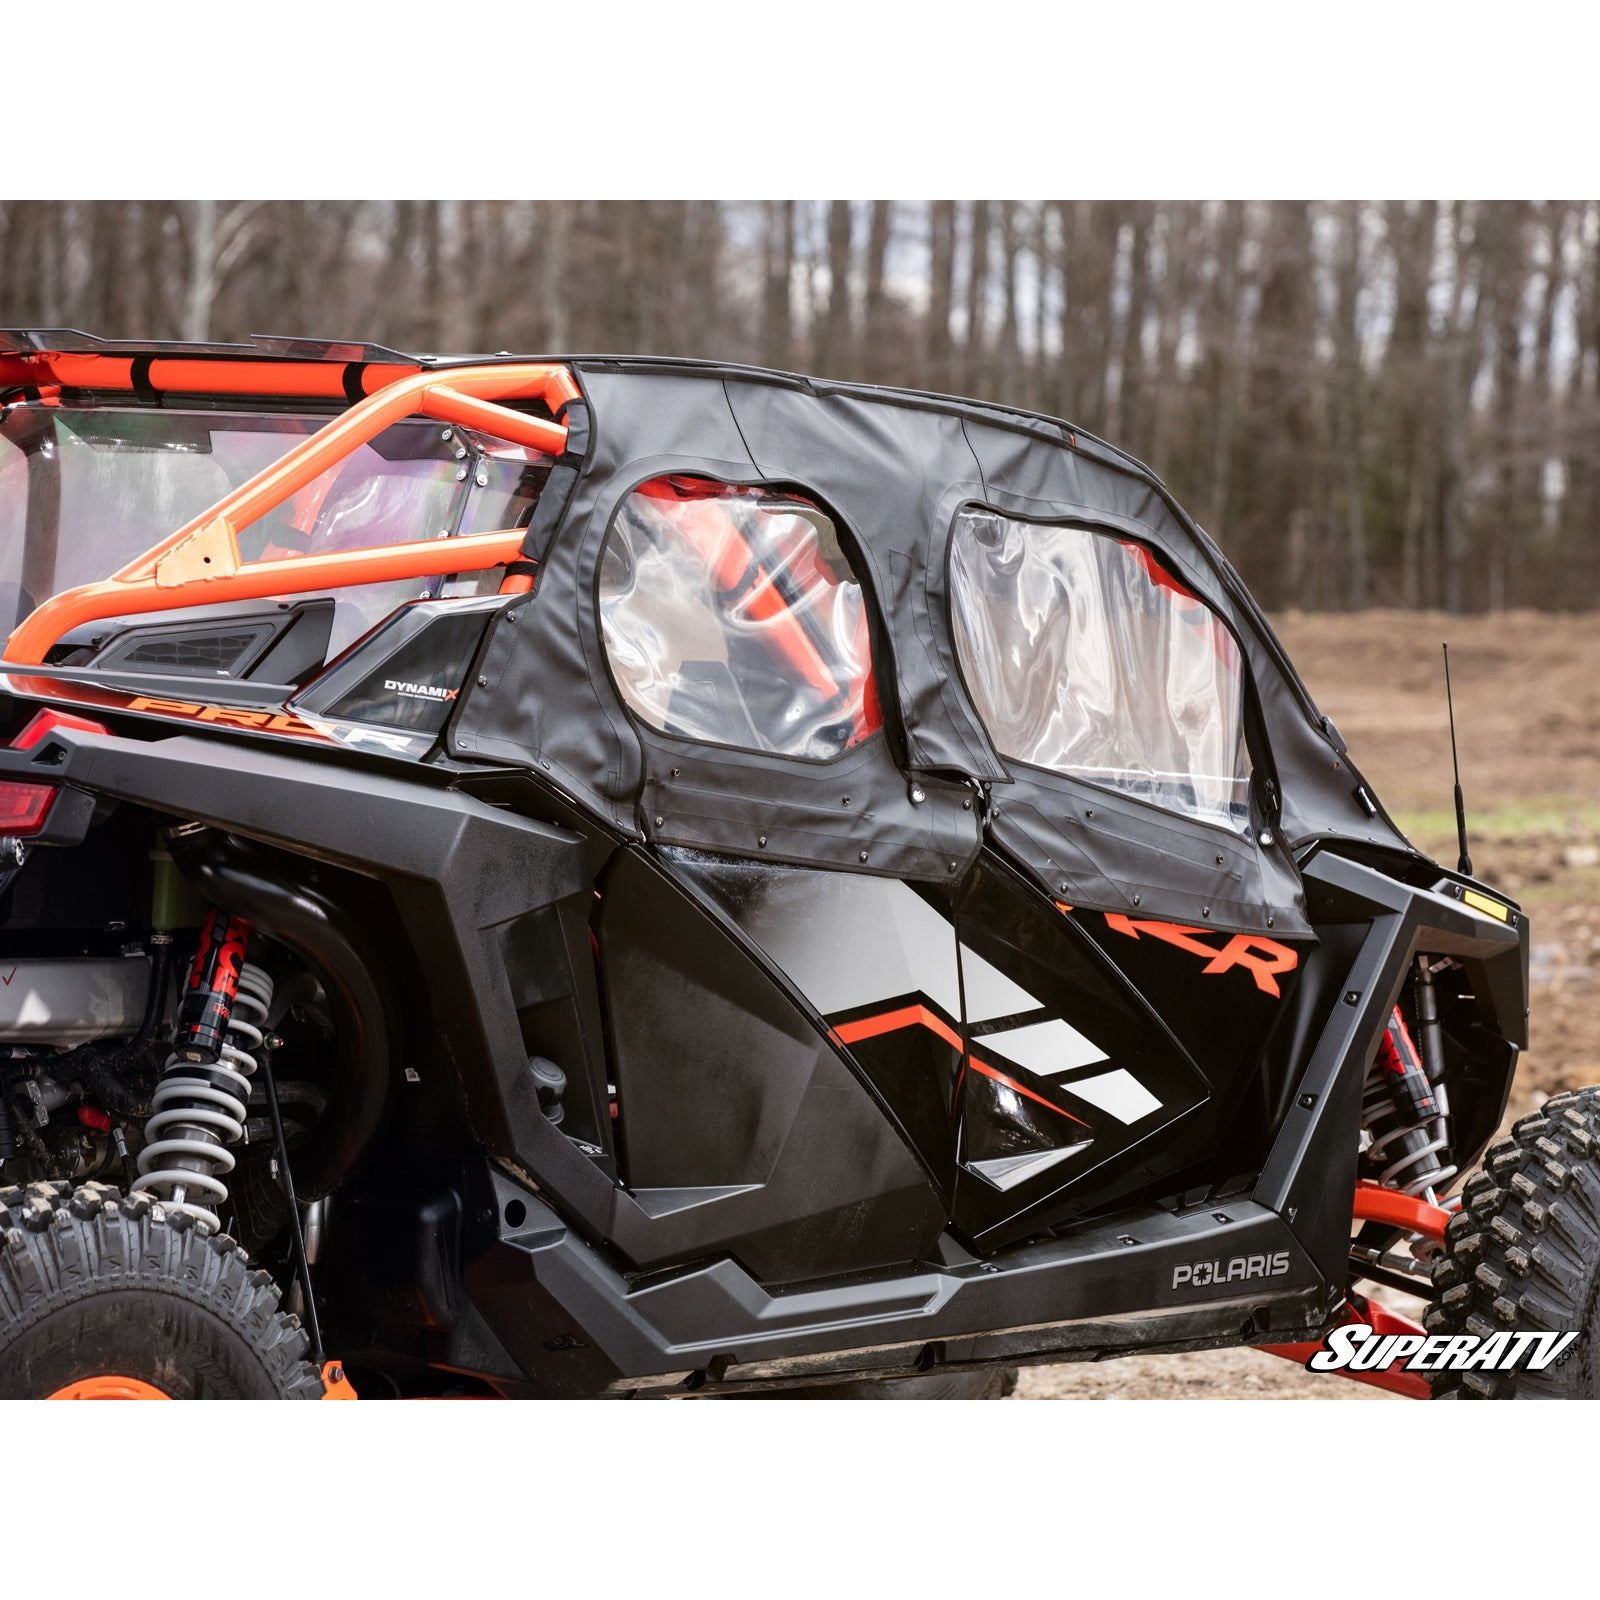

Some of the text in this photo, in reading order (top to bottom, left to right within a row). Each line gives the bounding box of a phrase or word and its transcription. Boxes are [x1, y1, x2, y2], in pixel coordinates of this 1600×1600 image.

[384, 680, 460, 702] DYNAMIX
[126, 697, 412, 752] PRO R
[1172, 1251, 1290, 1290] POLARIS
